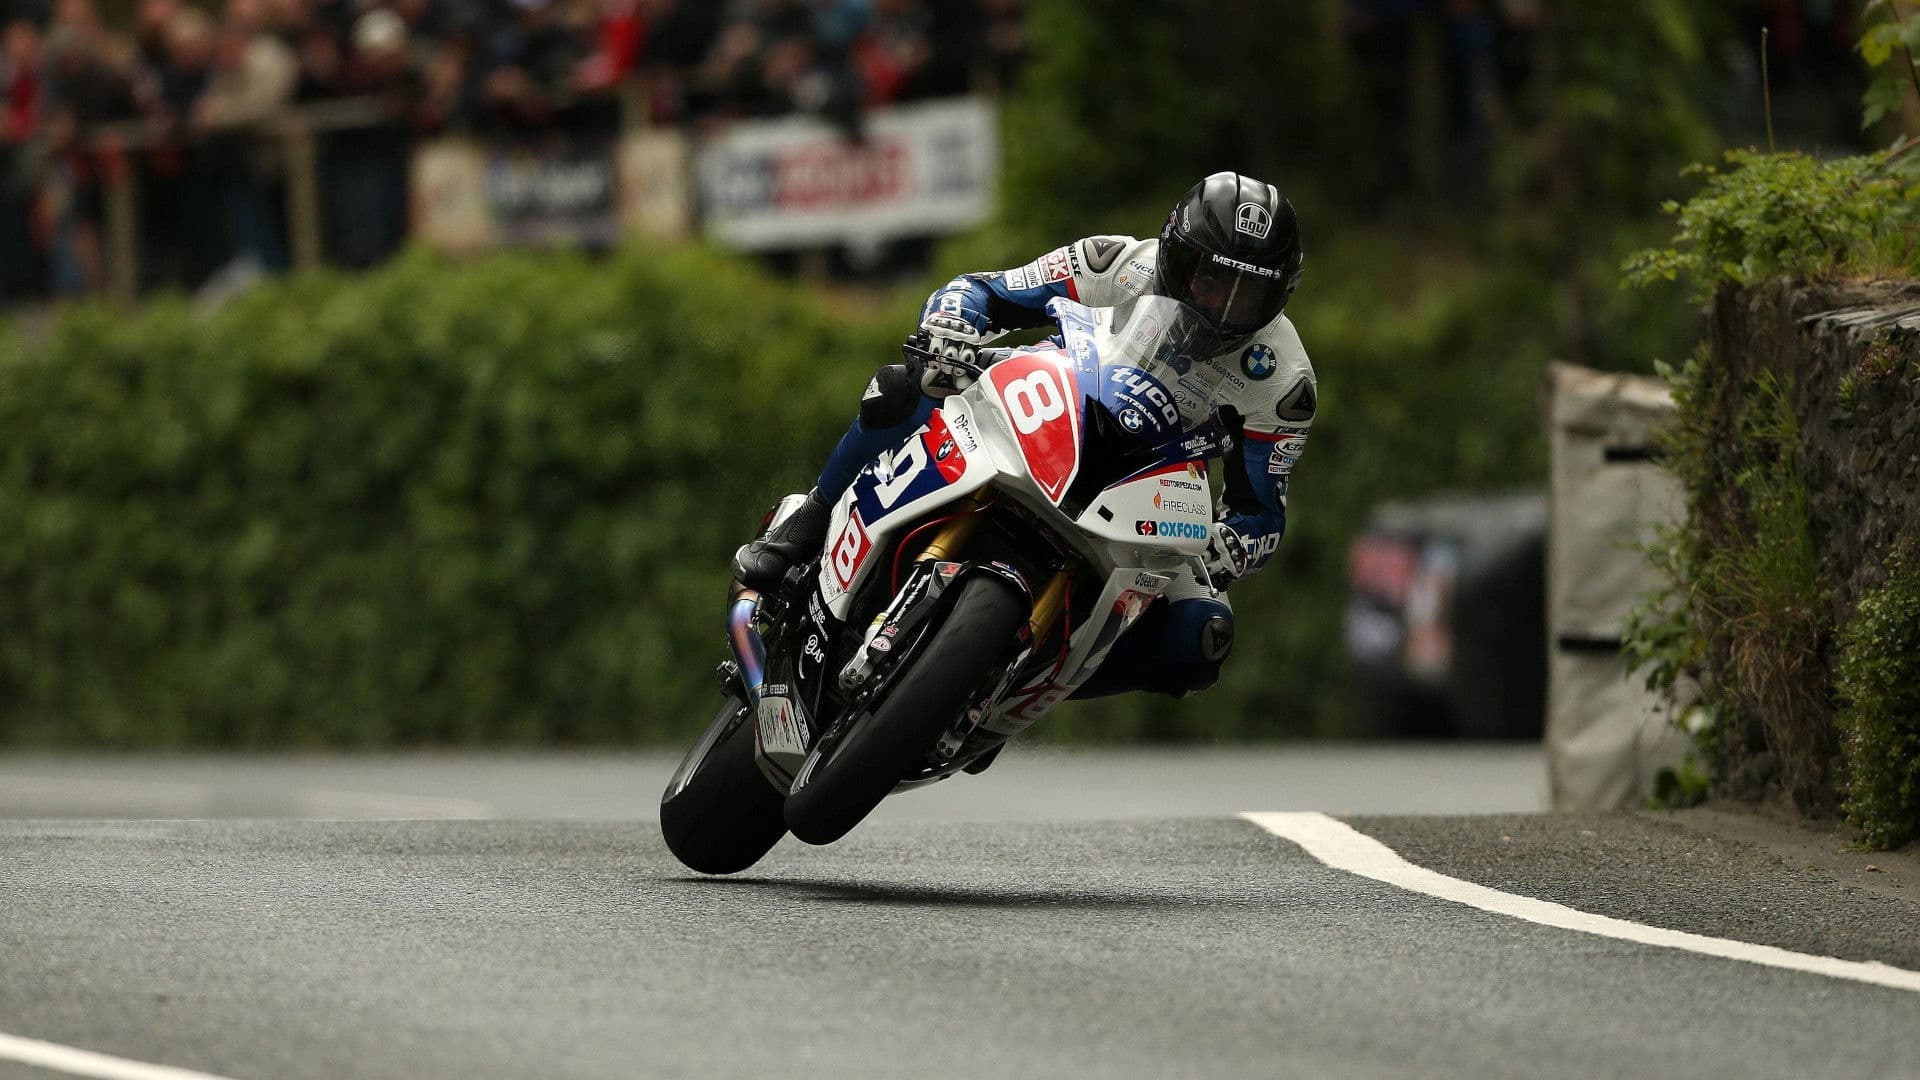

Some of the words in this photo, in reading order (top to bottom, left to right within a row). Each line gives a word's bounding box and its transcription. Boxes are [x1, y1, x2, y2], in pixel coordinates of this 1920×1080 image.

[1130, 260, 1155, 275] tyco
[1212, 254, 1273, 278] METZELER
[1253, 344, 1277, 367] BMW
[1003, 369, 1065, 434] 8
[1110, 367, 1178, 425] tyco
[1113, 391, 1158, 425] METZELER
[1163, 500, 1206, 515] FIRECLASS
[1158, 521, 1207, 539] OXFORD
[836, 517, 861, 582] 8
